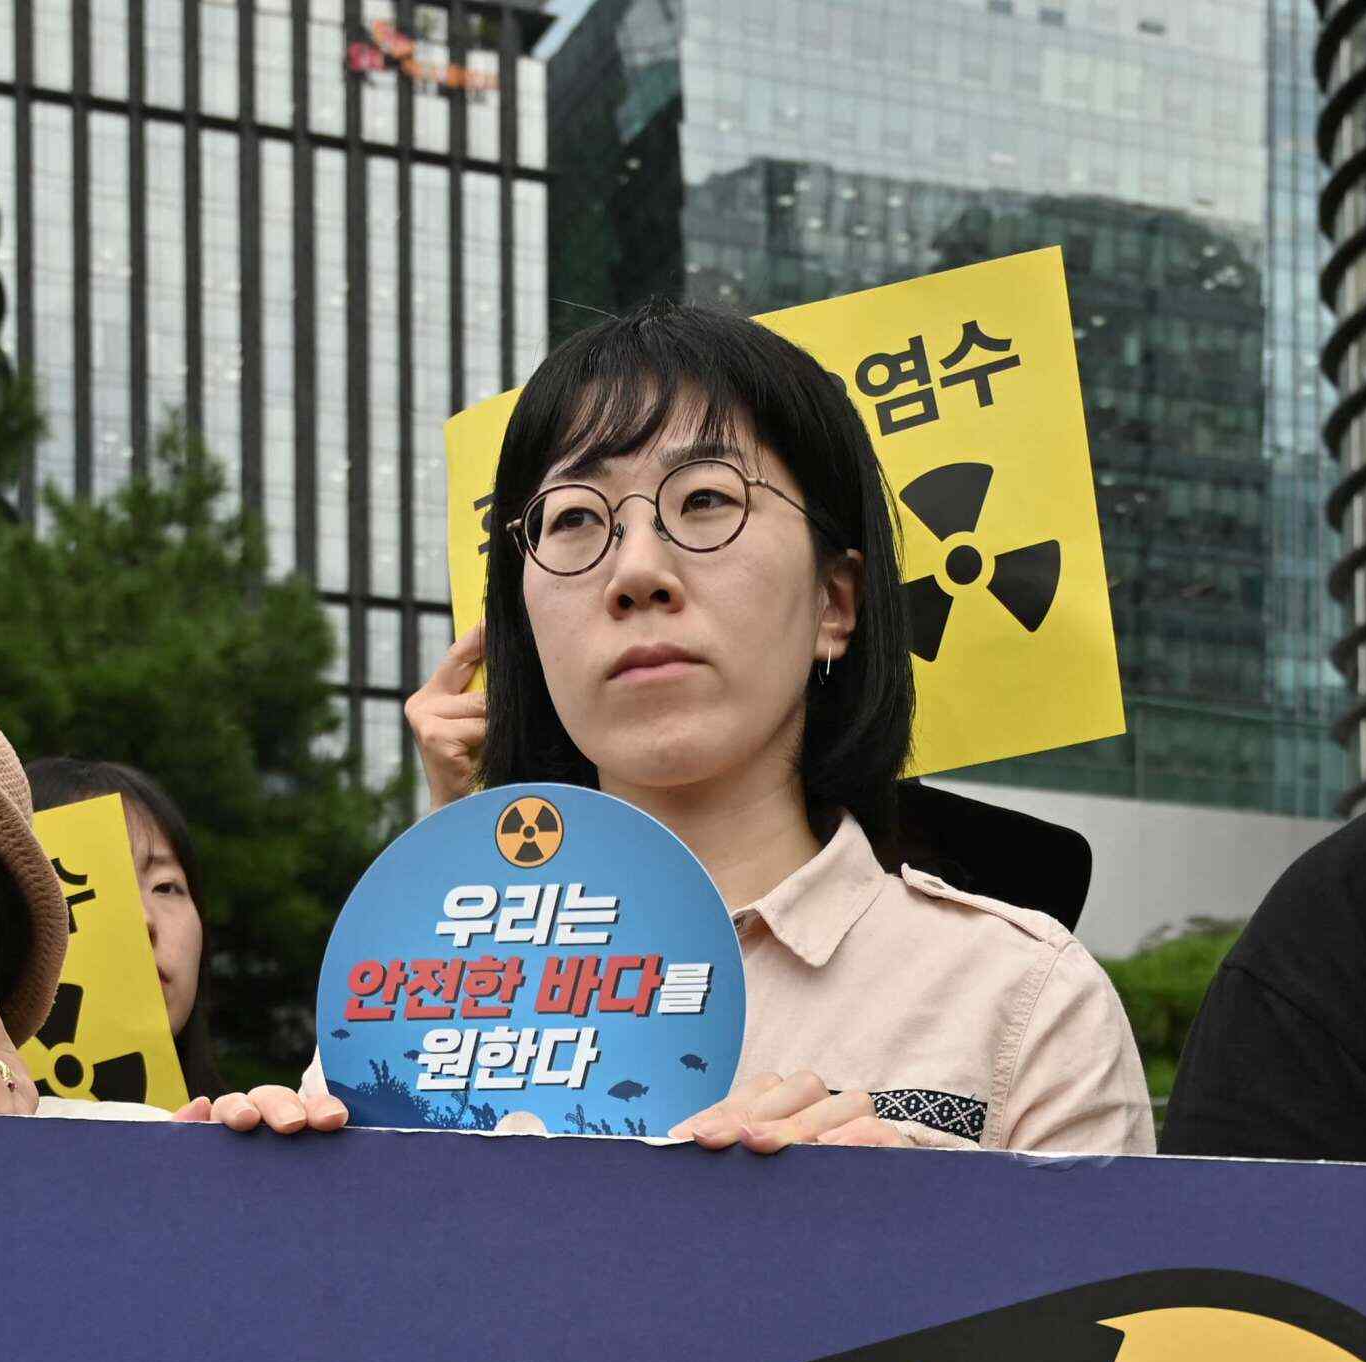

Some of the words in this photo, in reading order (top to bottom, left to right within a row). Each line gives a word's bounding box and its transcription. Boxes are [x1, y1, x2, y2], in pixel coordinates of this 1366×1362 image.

[827, 319, 1022, 437] 염수
[435, 883, 620, 948] 우리는
[343, 954, 525, 1022] 안전한
[534, 953, 714, 1020] 바다를
[415, 1025, 601, 1092] 원한다
